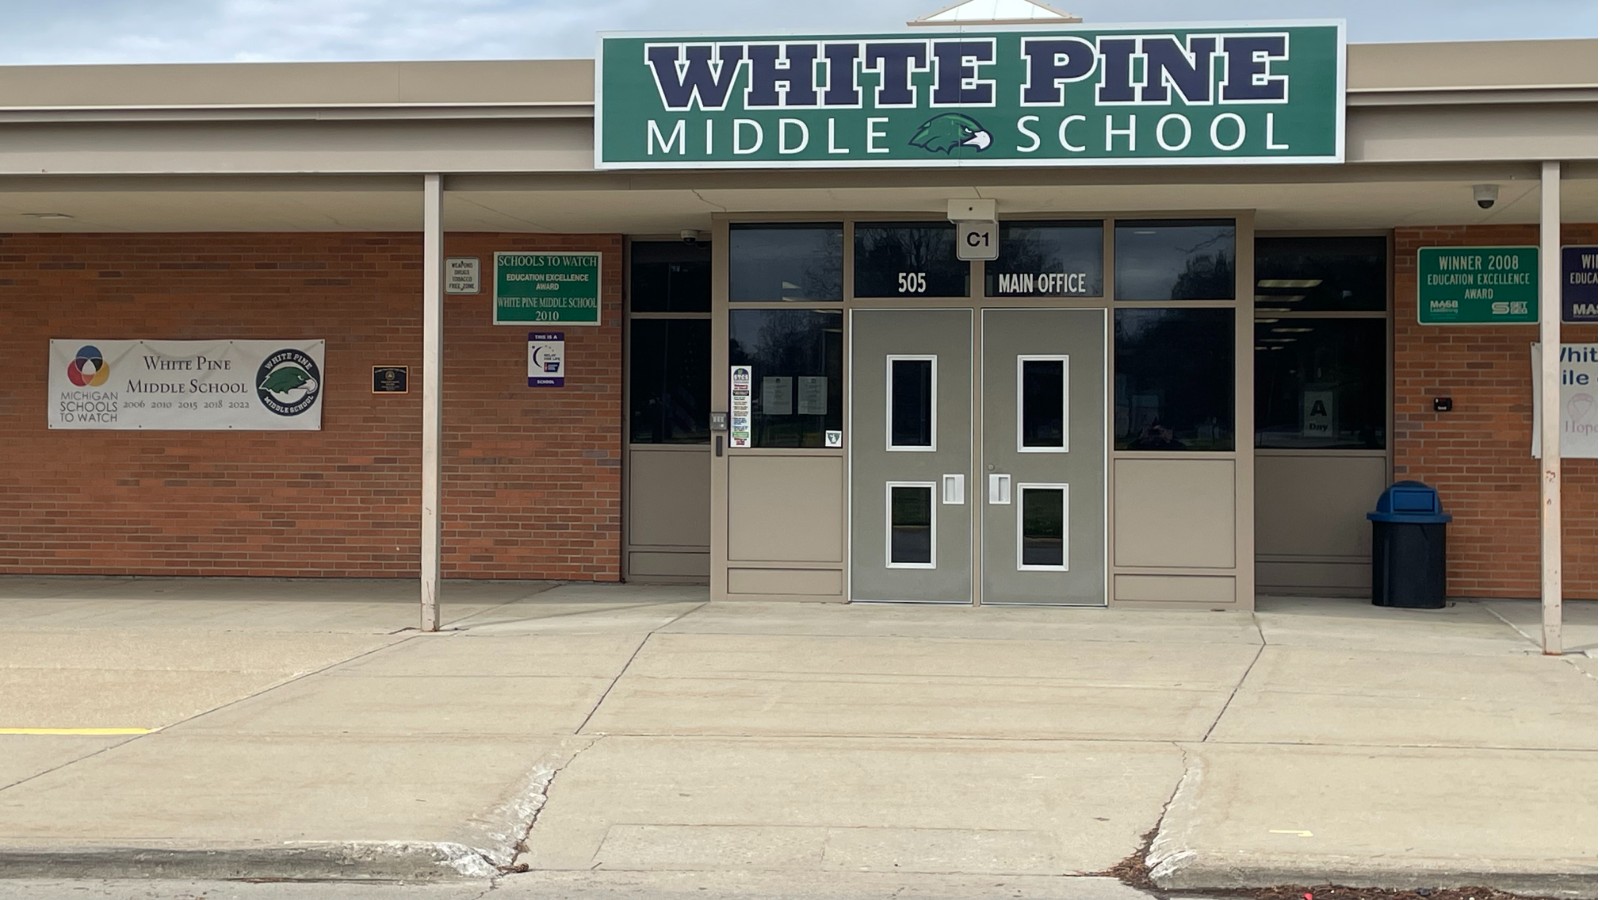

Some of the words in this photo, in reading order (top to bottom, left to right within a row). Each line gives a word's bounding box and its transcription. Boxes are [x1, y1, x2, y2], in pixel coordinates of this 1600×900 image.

[644, 38, 997, 111] WHITE
[1020, 33, 1290, 107] PINE
[647, 117, 890, 156] MIDDLE
[1017, 112, 1290, 153] SCHOOL
[966, 231, 990, 247] C1
[498, 255, 545, 267] SCHOOLS
[549, 255, 560, 267] TO
[562, 255, 598, 267] WATCH
[1439, 255, 1483, 271] WINNER
[1488, 255, 1519, 270] 2008
[506, 274, 545, 282] EDUCATION
[546, 274, 589, 282] EXCELLENCE
[898, 273, 926, 293] 505
[998, 273, 1034, 293] MAIN
[1037, 273, 1086, 293] OFFICE
[1427, 274, 1474, 285] EDUCATION
[1477, 273, 1530, 285] EXCELLENCE
[536, 283, 560, 291] AWARD
[1464, 288, 1494, 299] AWARD
[498, 297, 521, 308] WHITE
[522, 297, 538, 308] PINE
[540, 297, 567, 308] MIDDLE
[568, 297, 598, 308] SCHOOL
[535, 311, 560, 321] 2010
[264, 352, 293, 370] WHITE
[293, 354, 313, 370] PINE
[61, 391, 118, 401] MICHIGAN
[60, 401, 118, 412] SCHOOLS
[123, 400, 145, 409] 2006
[151, 401, 172, 409] 2010
[178, 401, 197, 410] 2015
[203, 400, 223, 409] 2018
[228, 401, 249, 409] 2022
[264, 396, 289, 413] MIDDLE
[289, 395, 314, 413] SCHOOL
[1310, 400, 1327, 417] A
[60, 413, 74, 422] TO
[77, 413, 118, 422] WATCH
[1308, 422, 1328, 432] Day
